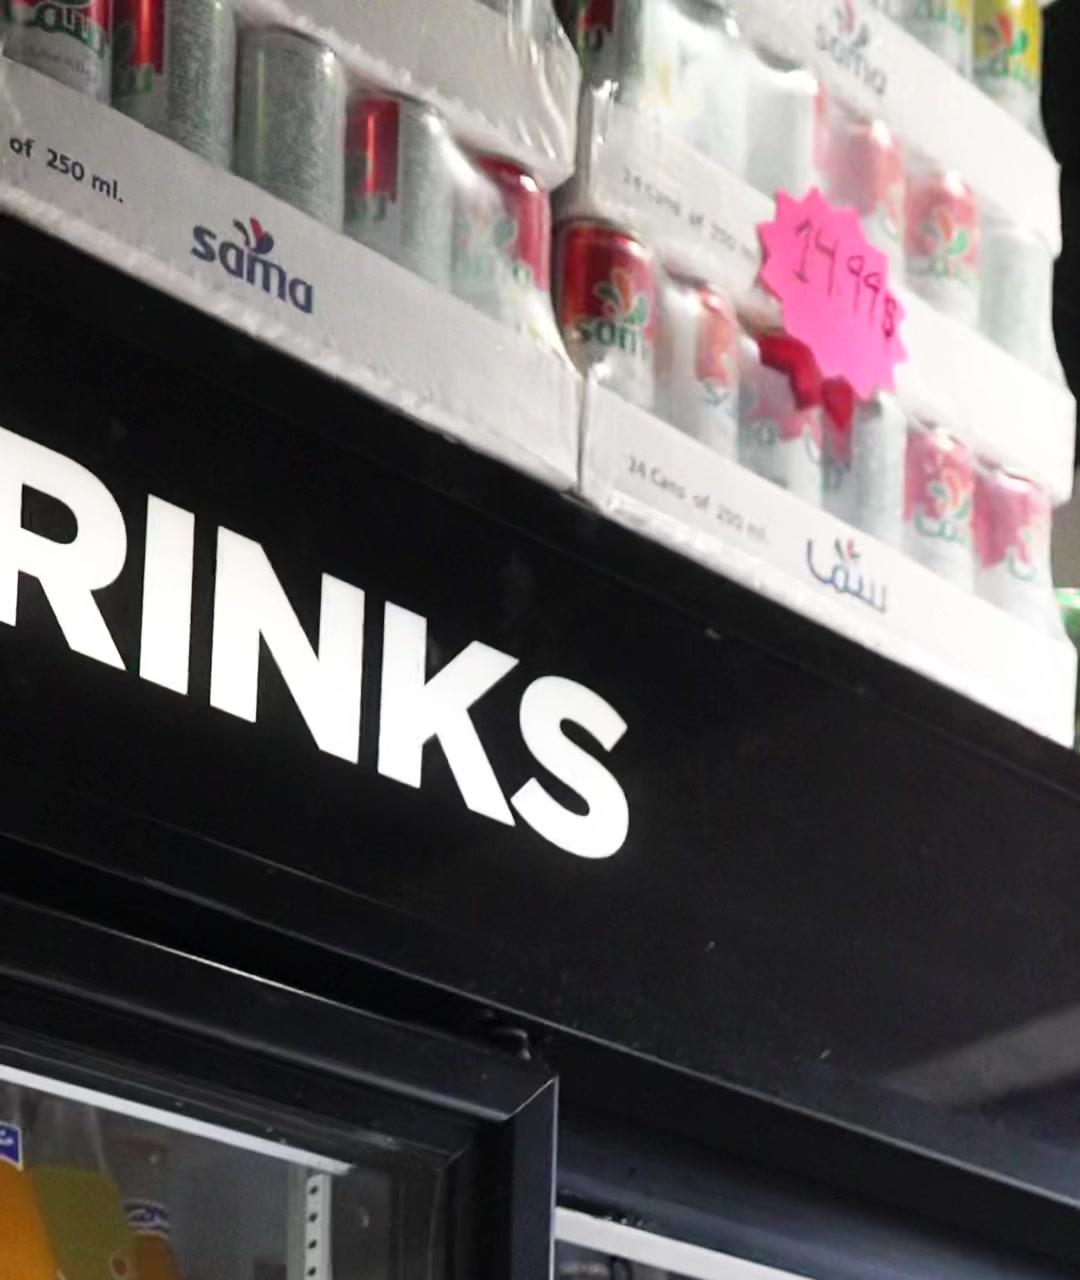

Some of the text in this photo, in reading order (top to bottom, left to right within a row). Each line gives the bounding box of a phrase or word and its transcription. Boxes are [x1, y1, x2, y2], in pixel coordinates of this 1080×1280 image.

[9, 137, 35, 158] of
[46, 147, 85, 181] 250
[190, 224, 313, 314] sama
[0, 426, 629, 859] RINKS
